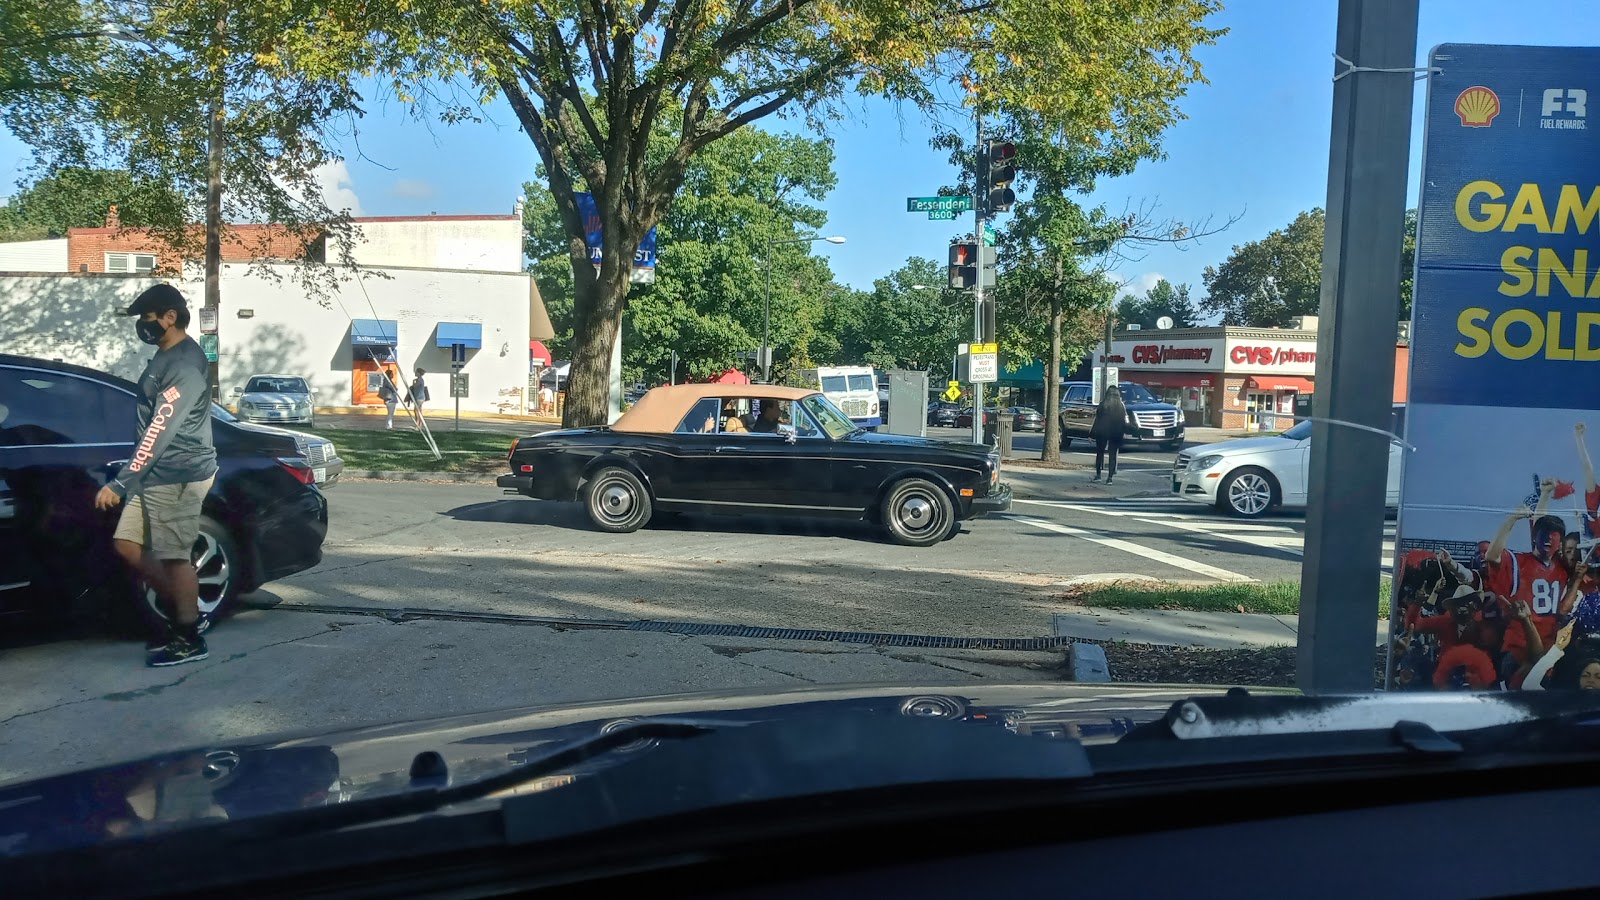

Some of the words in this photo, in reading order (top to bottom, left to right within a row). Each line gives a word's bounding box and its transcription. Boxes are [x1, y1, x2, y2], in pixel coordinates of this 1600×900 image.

[1540, 118, 1555, 129] FUEL
[1556, 119, 1586, 130] REWARDS
[910, 198, 965, 211] Fessenden
[929, 211, 953, 219] 3600
[1497, 245, 1600, 299] SN
[1132, 344, 1213, 364] CVS/pharmacy
[129, 403, 175, 473] Columbia
[1532, 578, 1560, 614] 81
